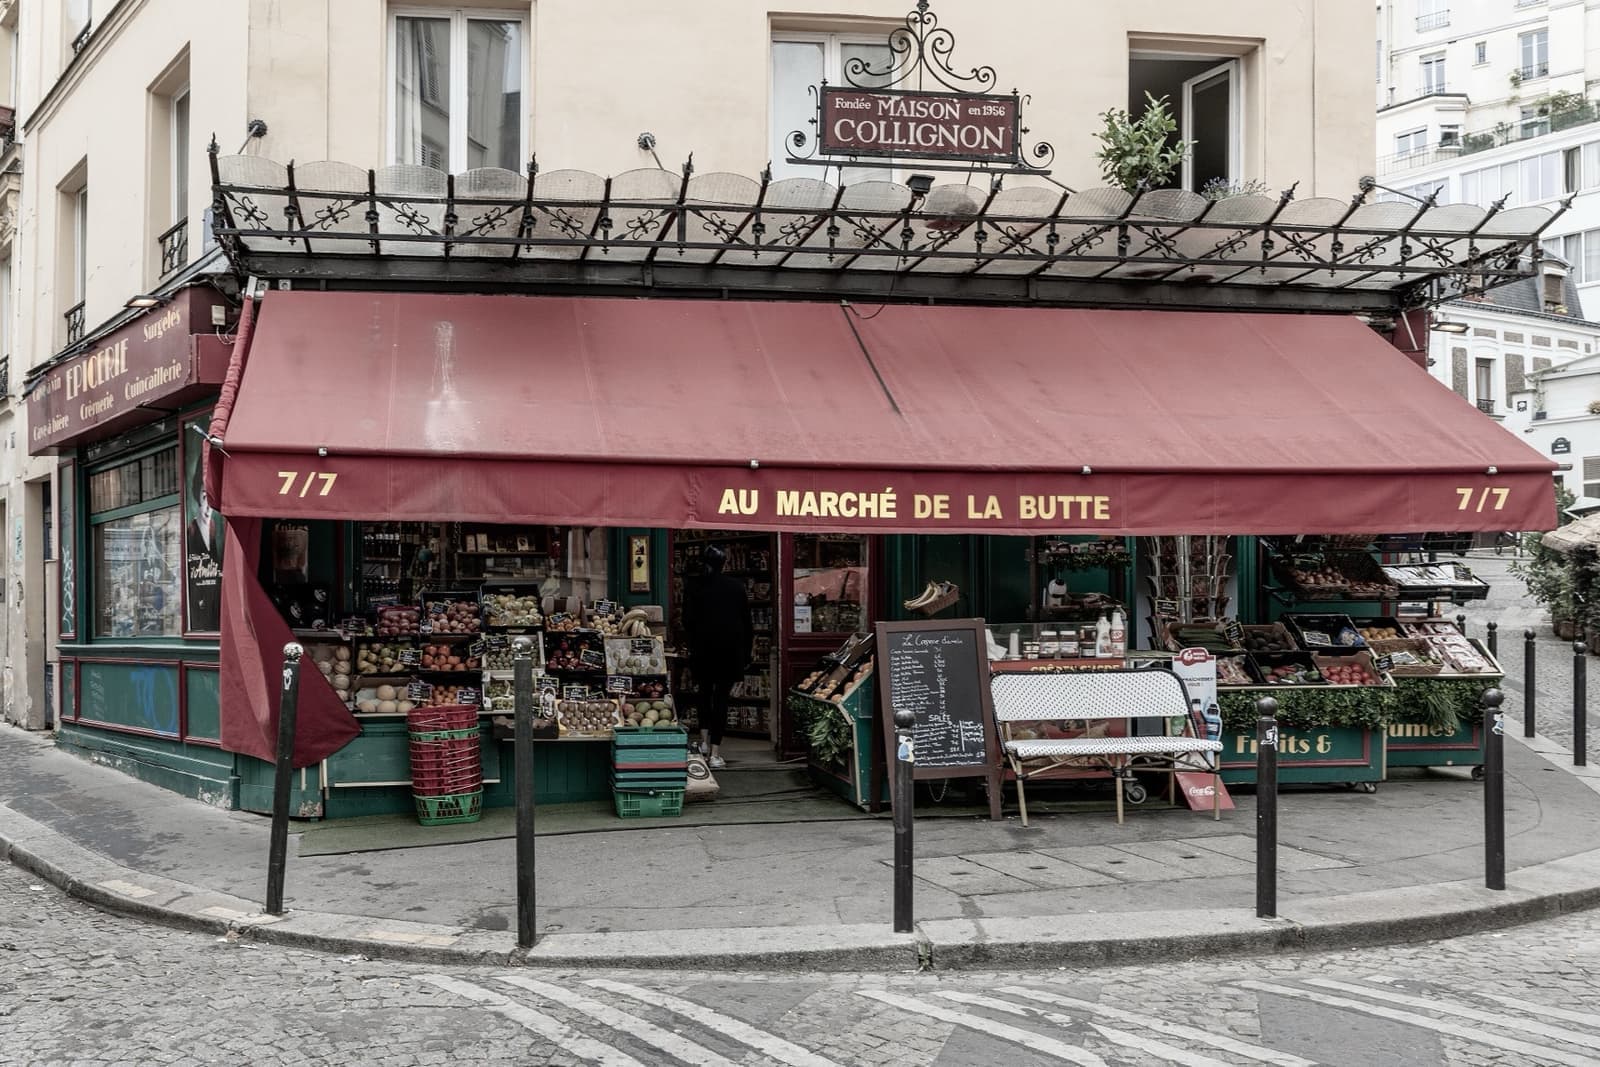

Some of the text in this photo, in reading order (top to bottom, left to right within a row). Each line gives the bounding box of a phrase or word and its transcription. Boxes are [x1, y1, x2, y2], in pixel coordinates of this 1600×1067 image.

[835, 98, 1006, 121] Fondée MAISON en 1956
[834, 119, 1006, 150] COLLIGNON
[143, 306, 181, 342] Surgelés
[66, 338, 129, 401] EPICERIE
[125, 359, 182, 401] Quincaillerie
[33, 425, 47, 441] Cave
[277, 471, 338, 498] 7/7
[718, 487, 1111, 520] AU MARCHÉ DE LA BUTTE
[1456, 487, 1510, 513] 7/7
[1236, 733, 1332, 754] Frits &
